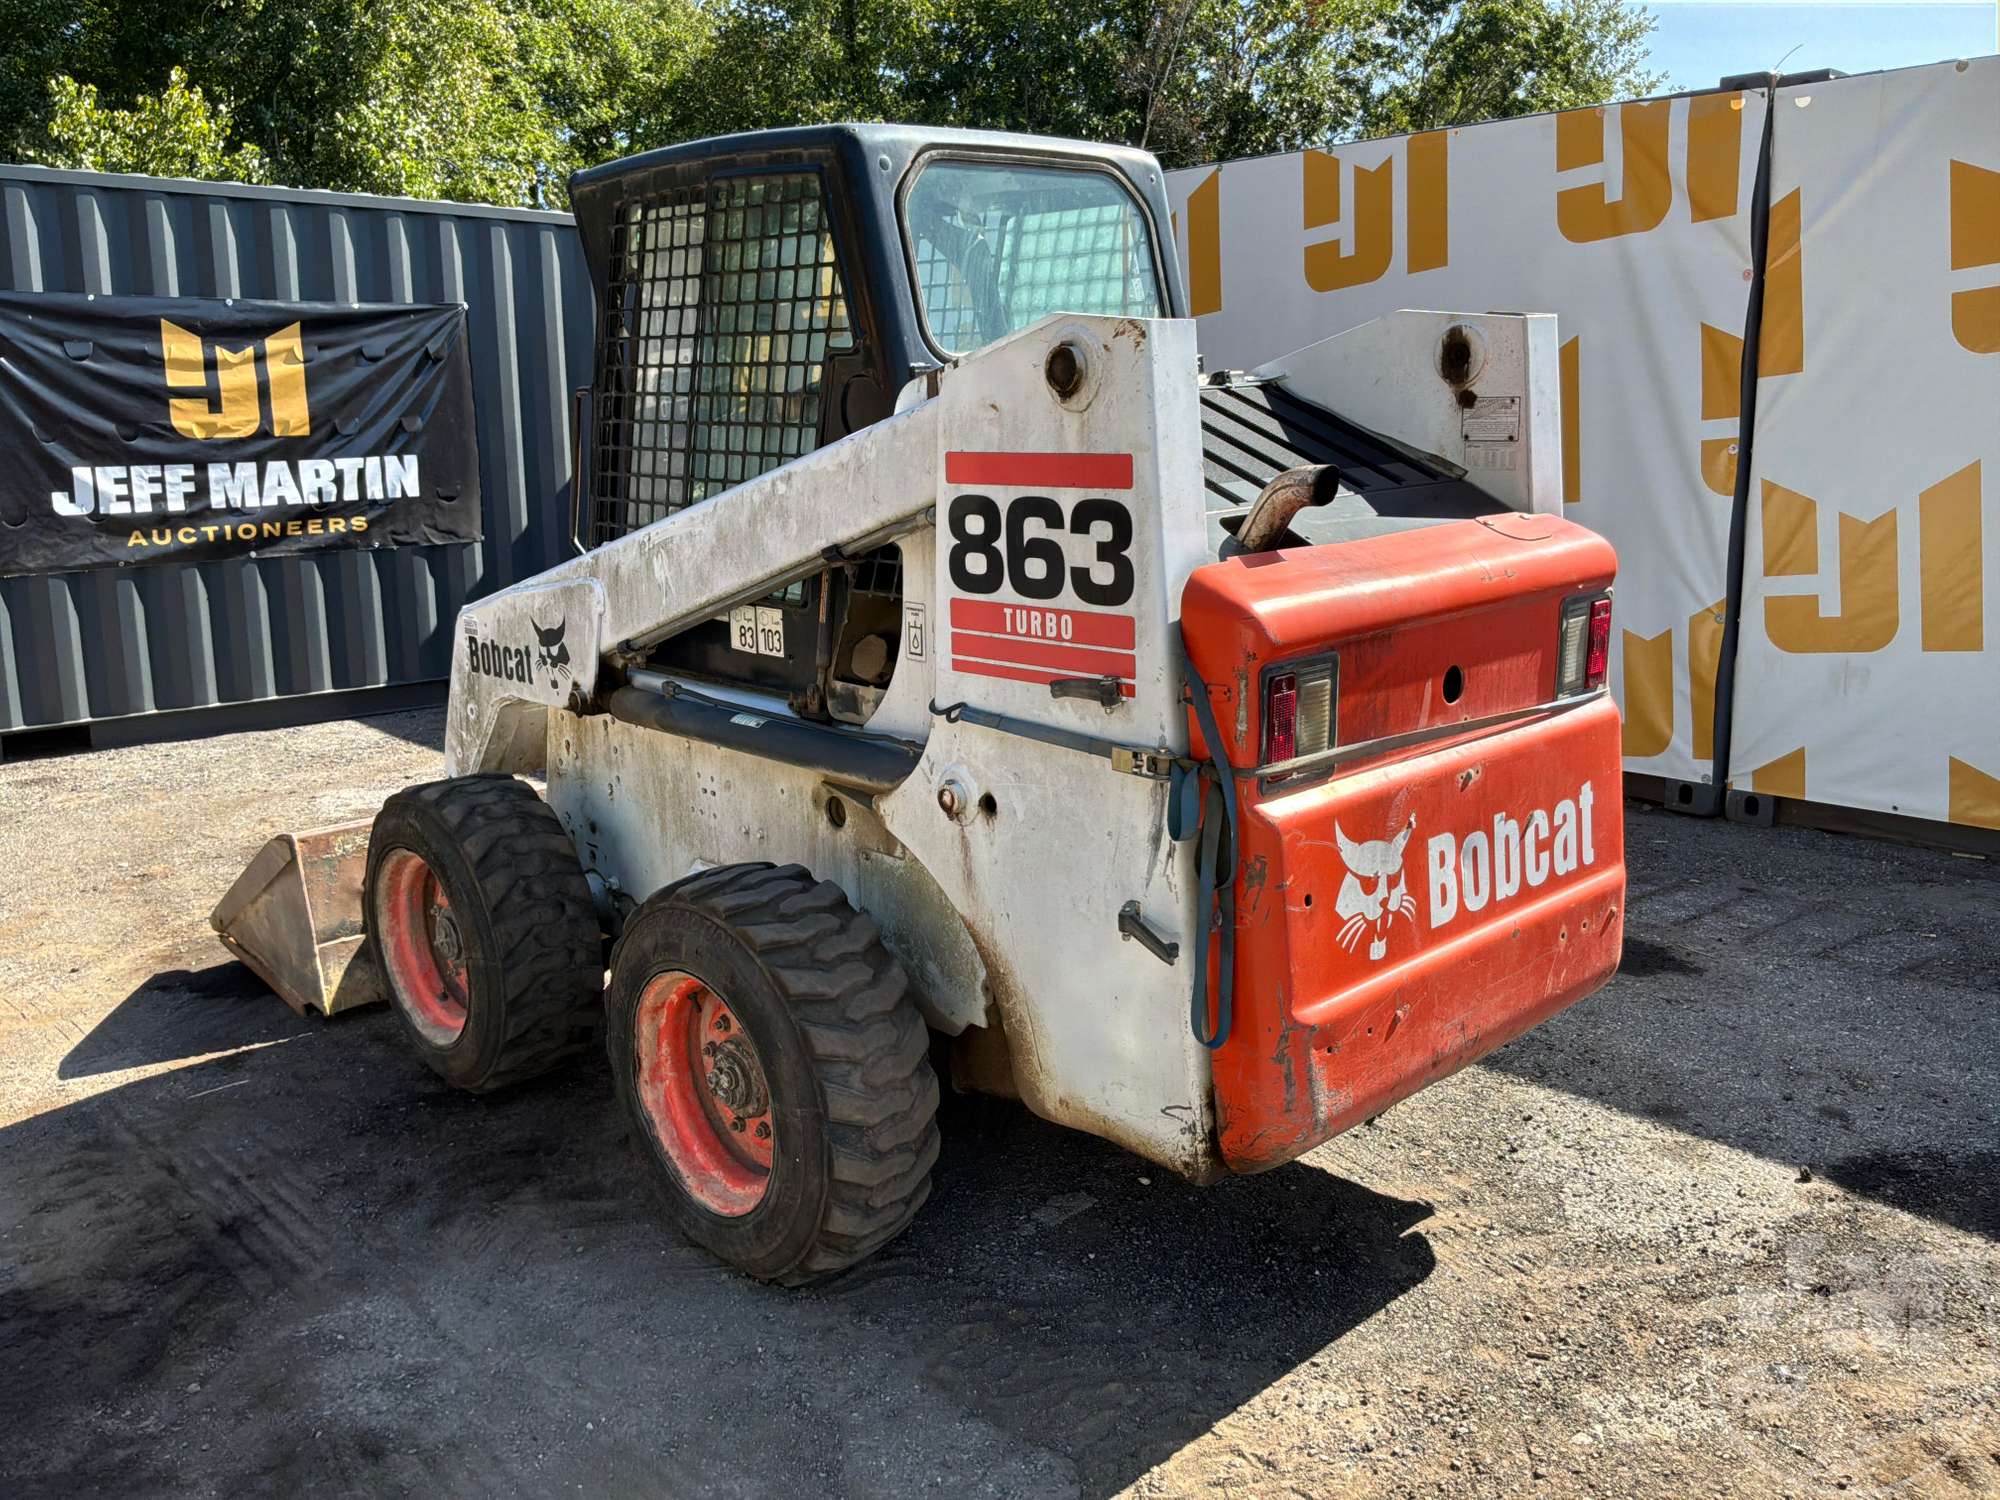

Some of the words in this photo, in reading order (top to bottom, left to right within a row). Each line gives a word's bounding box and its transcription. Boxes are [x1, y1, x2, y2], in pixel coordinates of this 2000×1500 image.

[51, 463, 196, 516] JEFF
[208, 454, 420, 509] MARTIN
[127, 516, 369, 548] AUCTIONEERS
[948, 494, 1135, 607] 863
[739, 624, 755, 649] 83
[760, 627, 782, 653] 103
[1004, 607, 1073, 641] TURBO
[468, 635, 534, 685] Bobcat
[1427, 780, 1595, 929] Bobcat
